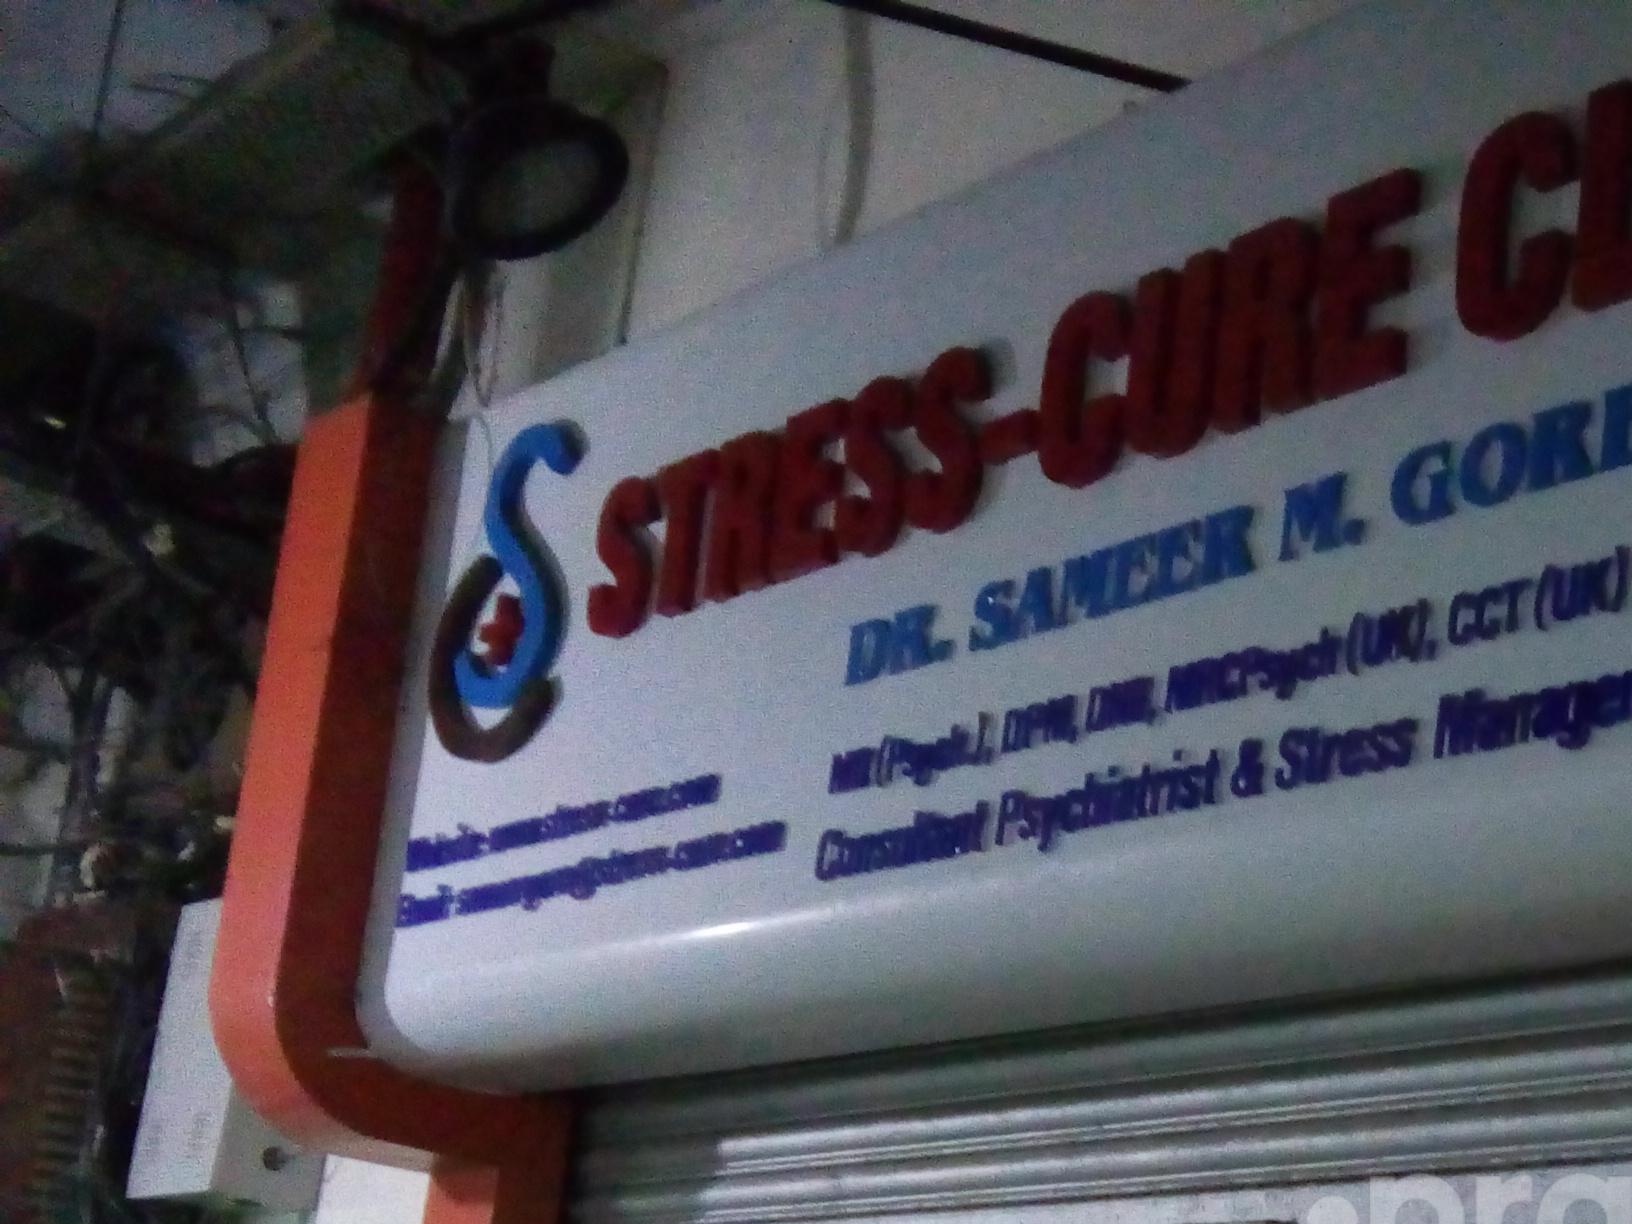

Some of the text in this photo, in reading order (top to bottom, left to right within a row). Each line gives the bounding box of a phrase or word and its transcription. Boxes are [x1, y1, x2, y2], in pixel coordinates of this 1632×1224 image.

[588, 168, 1424, 638] STRESS-CURE
[846, 605, 955, 686] DR.
[968, 506, 1256, 652] SAMEER
[1279, 471, 1366, 562] M.
[1449, 578, 1533, 647] CCT
[815, 800, 992, 881] Consultant
[995, 748, 1222, 853] Psychiatrist
[1230, 737, 1265, 799] &
[1275, 716, 1420, 791] Stress
